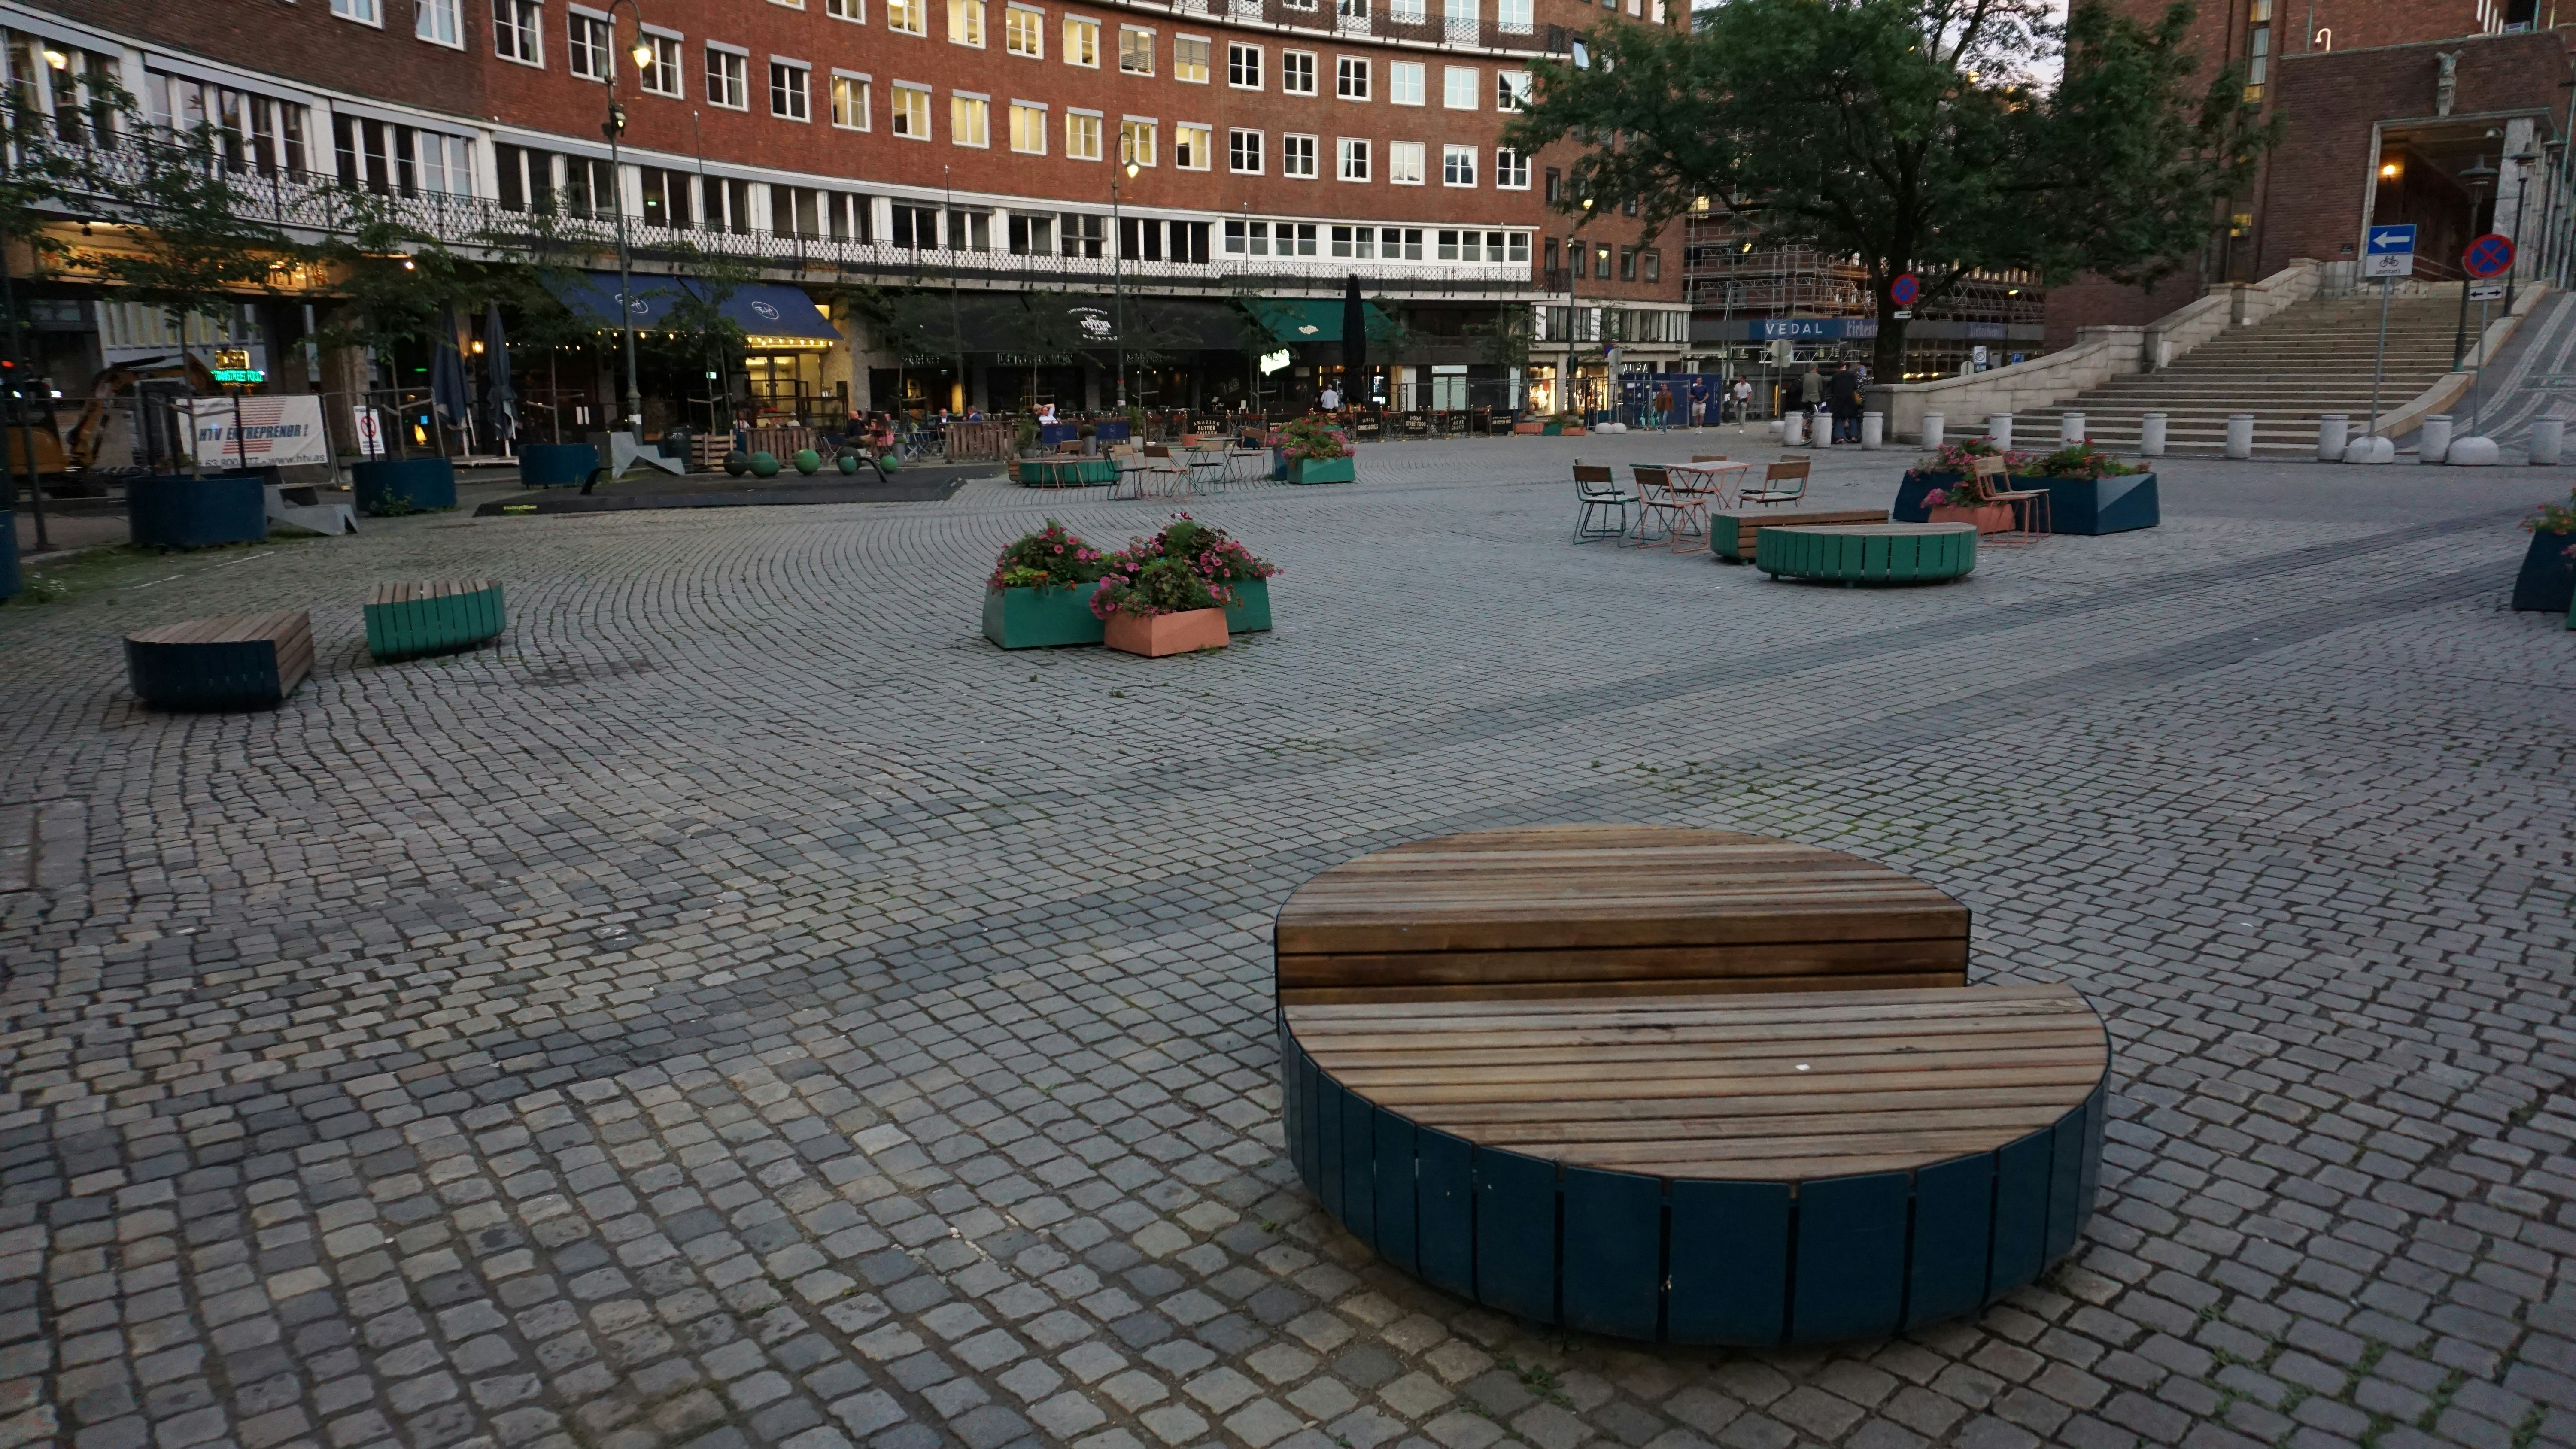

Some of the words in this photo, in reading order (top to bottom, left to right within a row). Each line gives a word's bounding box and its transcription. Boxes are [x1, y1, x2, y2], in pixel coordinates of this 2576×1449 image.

[1765, 323, 1823, 334] VEDAL
[2014, 353, 2020, 361] P
[198, 428, 223, 441] HTV
[205, 458, 218, 467] 63
[269, 454, 325, 464] www.htv.as
